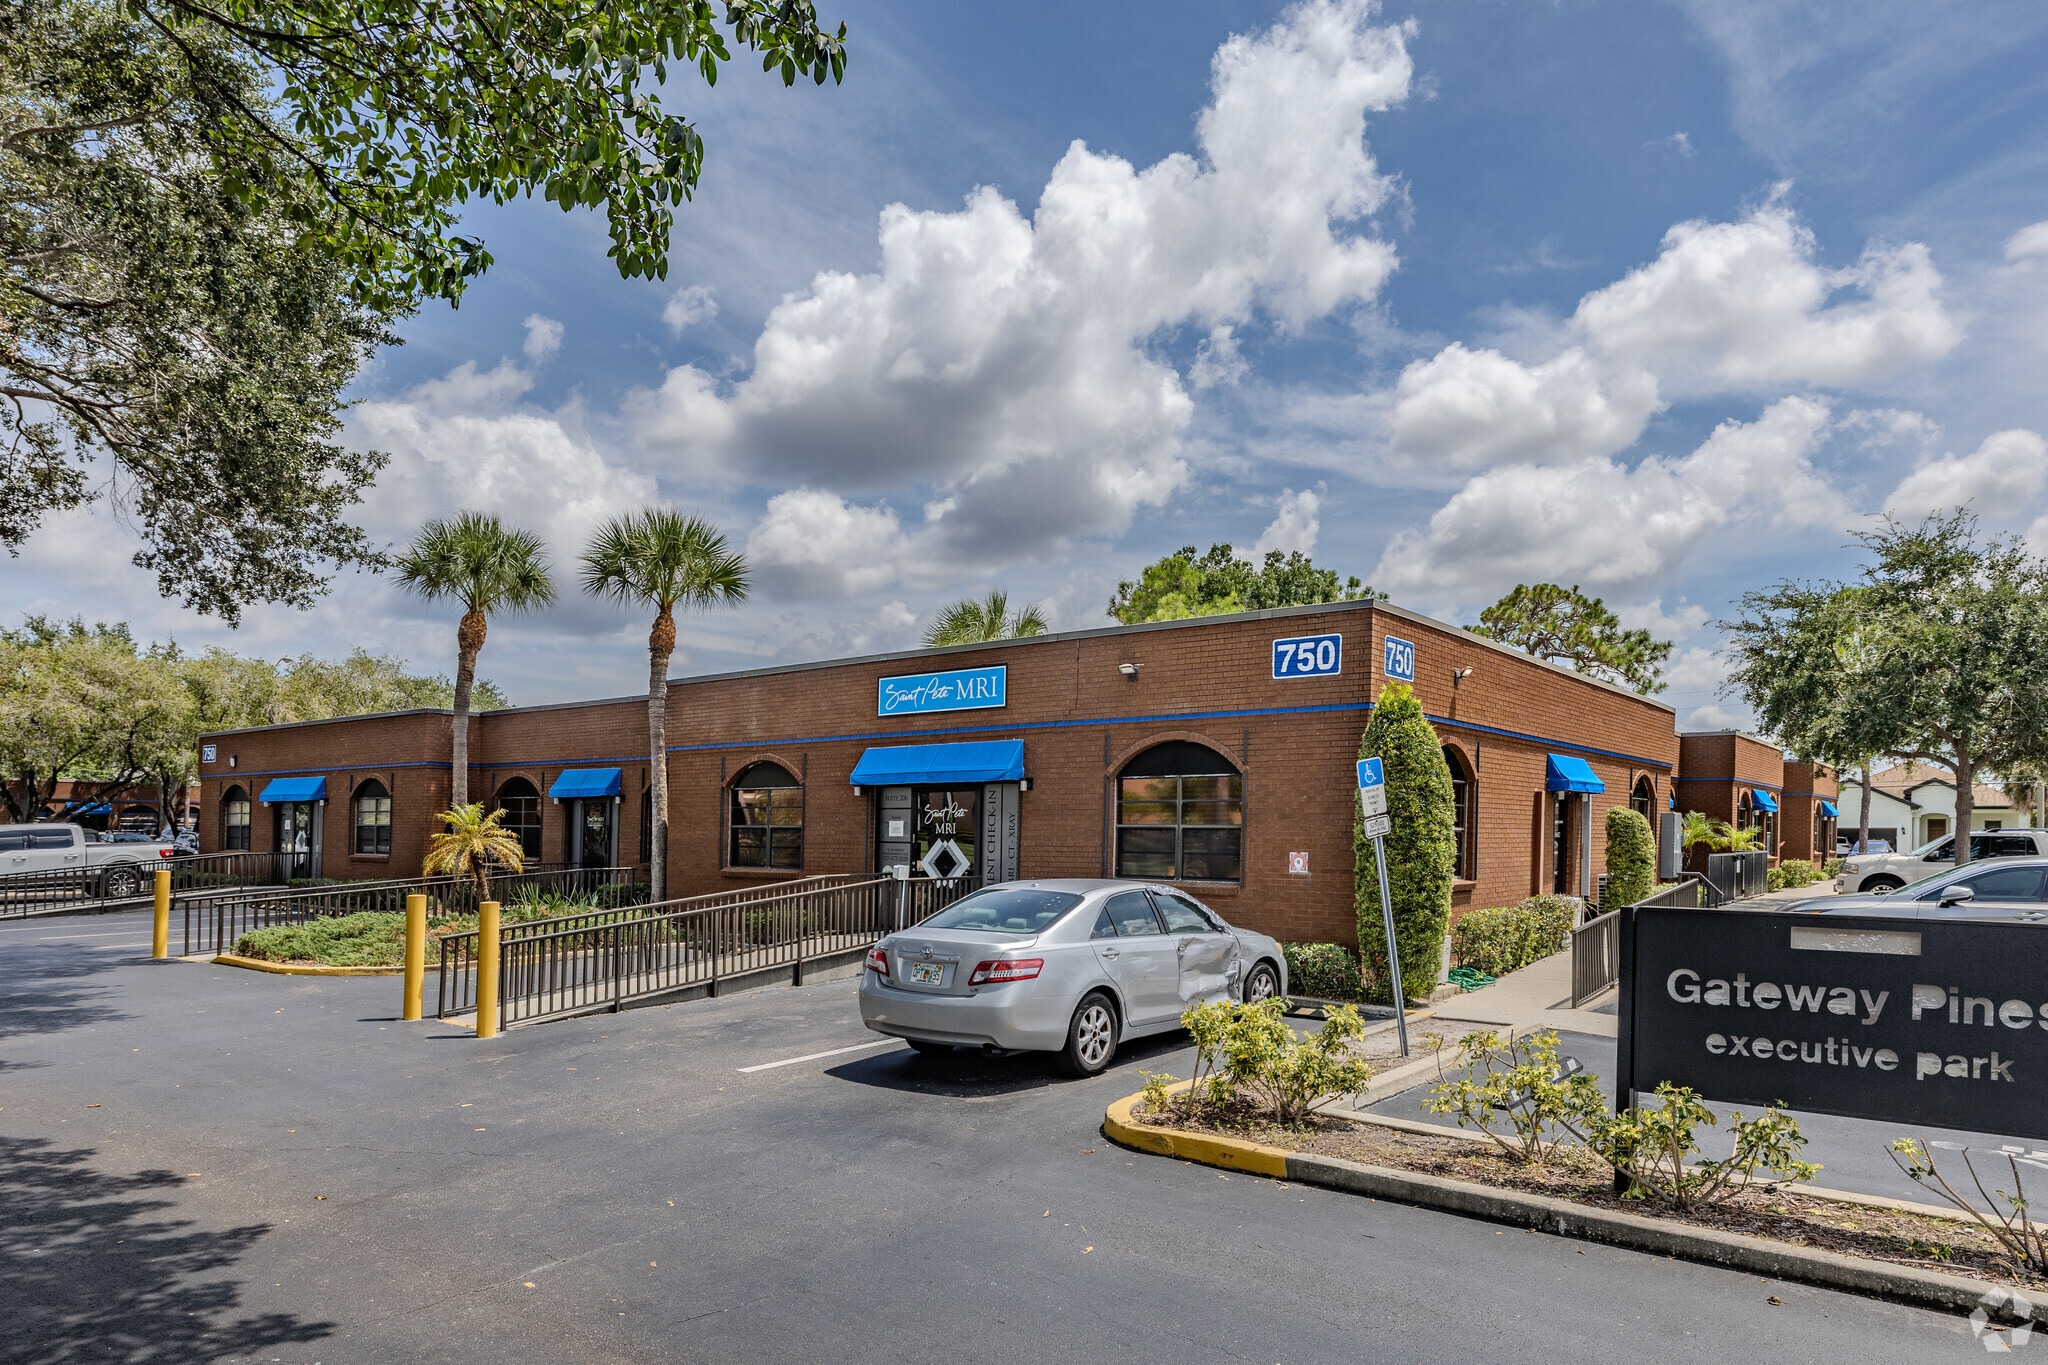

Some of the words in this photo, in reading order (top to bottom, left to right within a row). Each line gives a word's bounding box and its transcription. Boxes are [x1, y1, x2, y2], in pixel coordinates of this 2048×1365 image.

[1277, 640, 1336, 673] 750
[1387, 642, 1412, 675] 750
[885, 684, 925, 711] Saint
[921, 677, 954, 705] Pete
[956, 676, 998, 700] MRI
[204, 747, 214, 760] 750
[924, 804, 949, 825] Saint
[947, 801, 968, 821] Pete
[935, 822, 957, 834] MRI
[987, 790, 996, 853] CHECK-IN
[1008, 846, 1015, 859] CT
[987, 859, 995, 885] IENT
[1666, 968, 1890, 1026] Gateway
[1911, 983, 2048, 1031] Pine
[1705, 1033, 1899, 1071] executive
[1916, 1051, 2016, 1083] park
